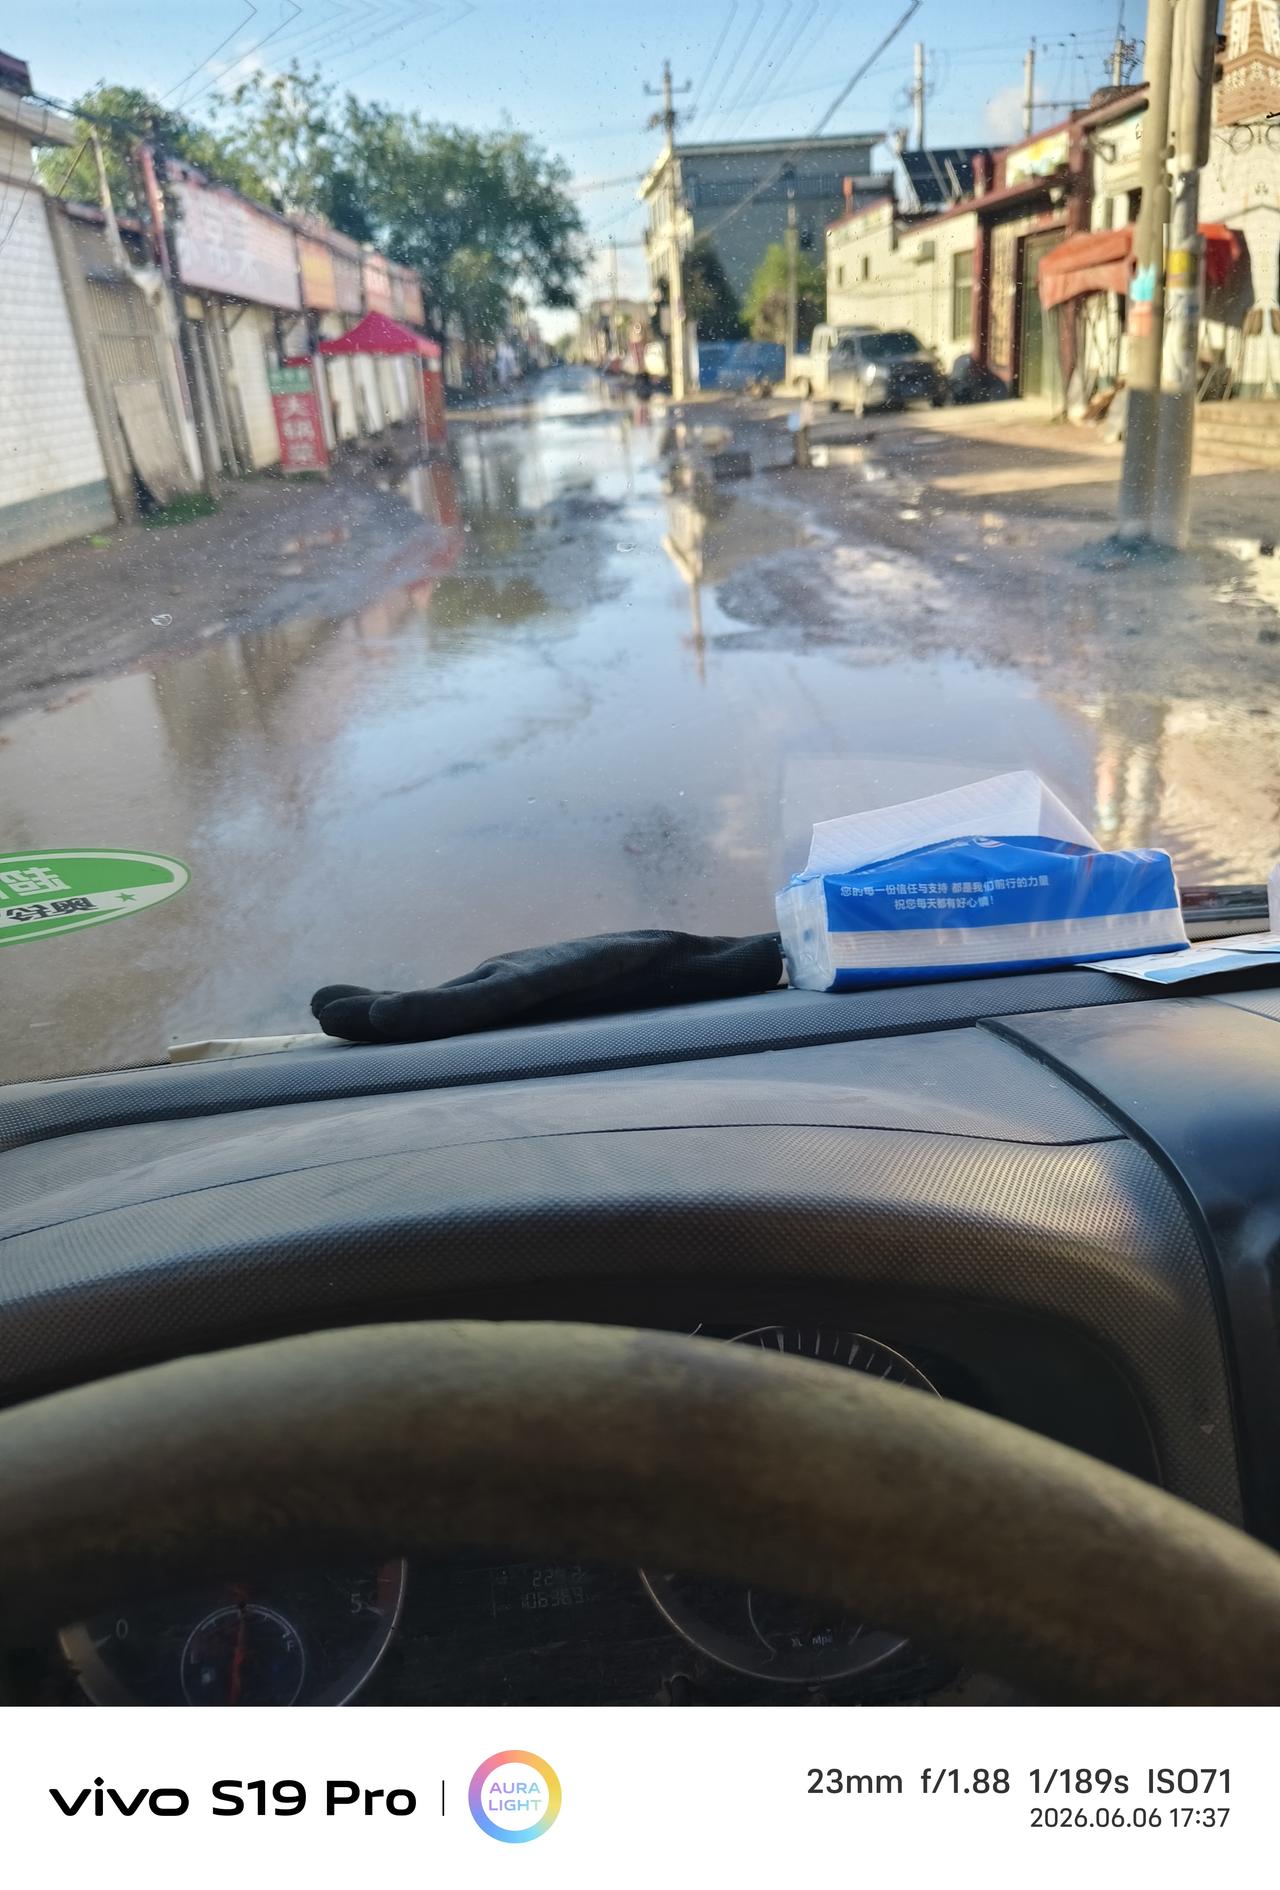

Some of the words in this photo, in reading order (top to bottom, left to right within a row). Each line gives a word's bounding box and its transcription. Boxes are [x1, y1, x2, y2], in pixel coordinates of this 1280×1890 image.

[840, 883, 948, 897] 您的每一份信任与支持
[951, 875, 1049, 894] 都是我们前行的力量
[350, 1593, 361, 1613] 5
[116, 1619, 128, 1640] 0
